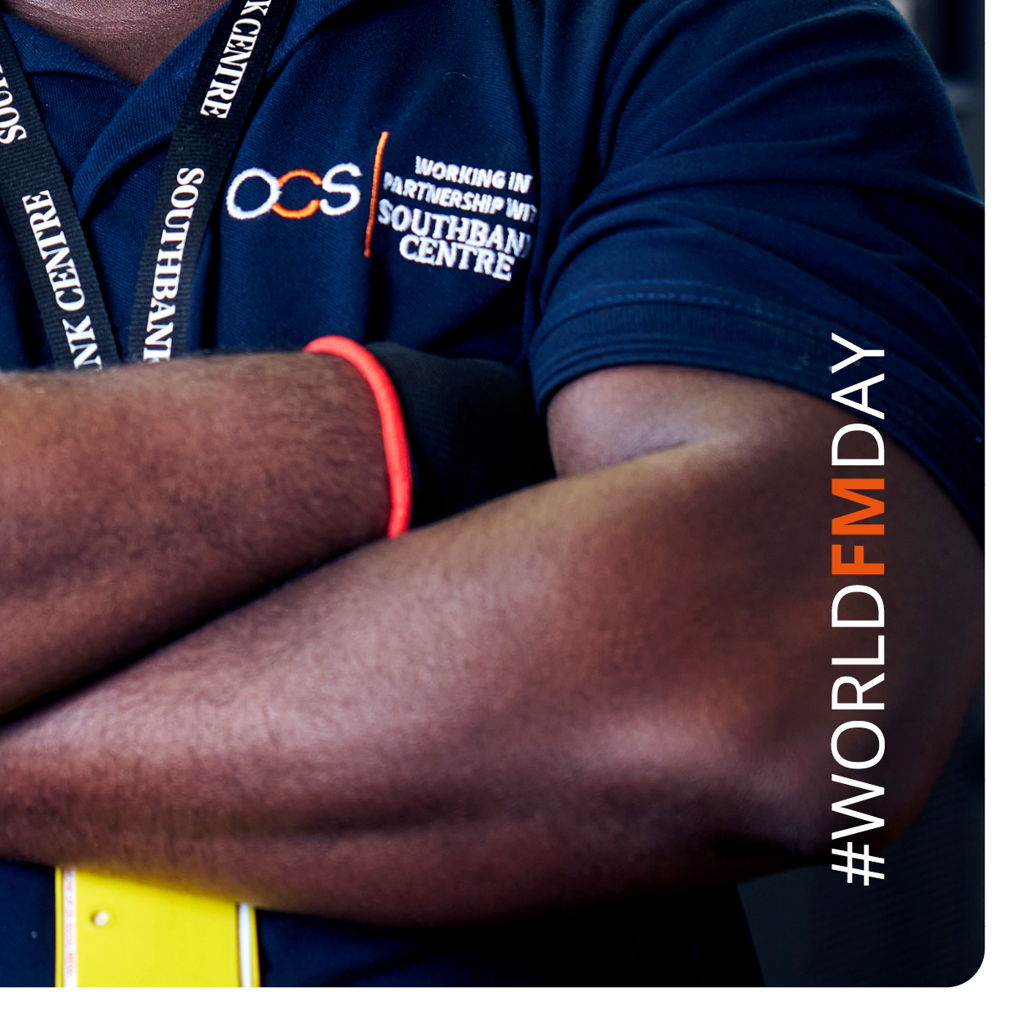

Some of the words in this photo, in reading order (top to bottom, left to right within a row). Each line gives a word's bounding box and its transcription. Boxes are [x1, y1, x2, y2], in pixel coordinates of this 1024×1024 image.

[200, 18, 262, 119] CENTRE
[226, 163, 363, 220] OCS
[383, 171, 505, 214] PARTNERSHIP
[415, 155, 506, 189] WORKING
[508, 171, 533, 194] IN
[22, 189, 85, 312] CENTRE
[398, 233, 516, 282] CENTRE
